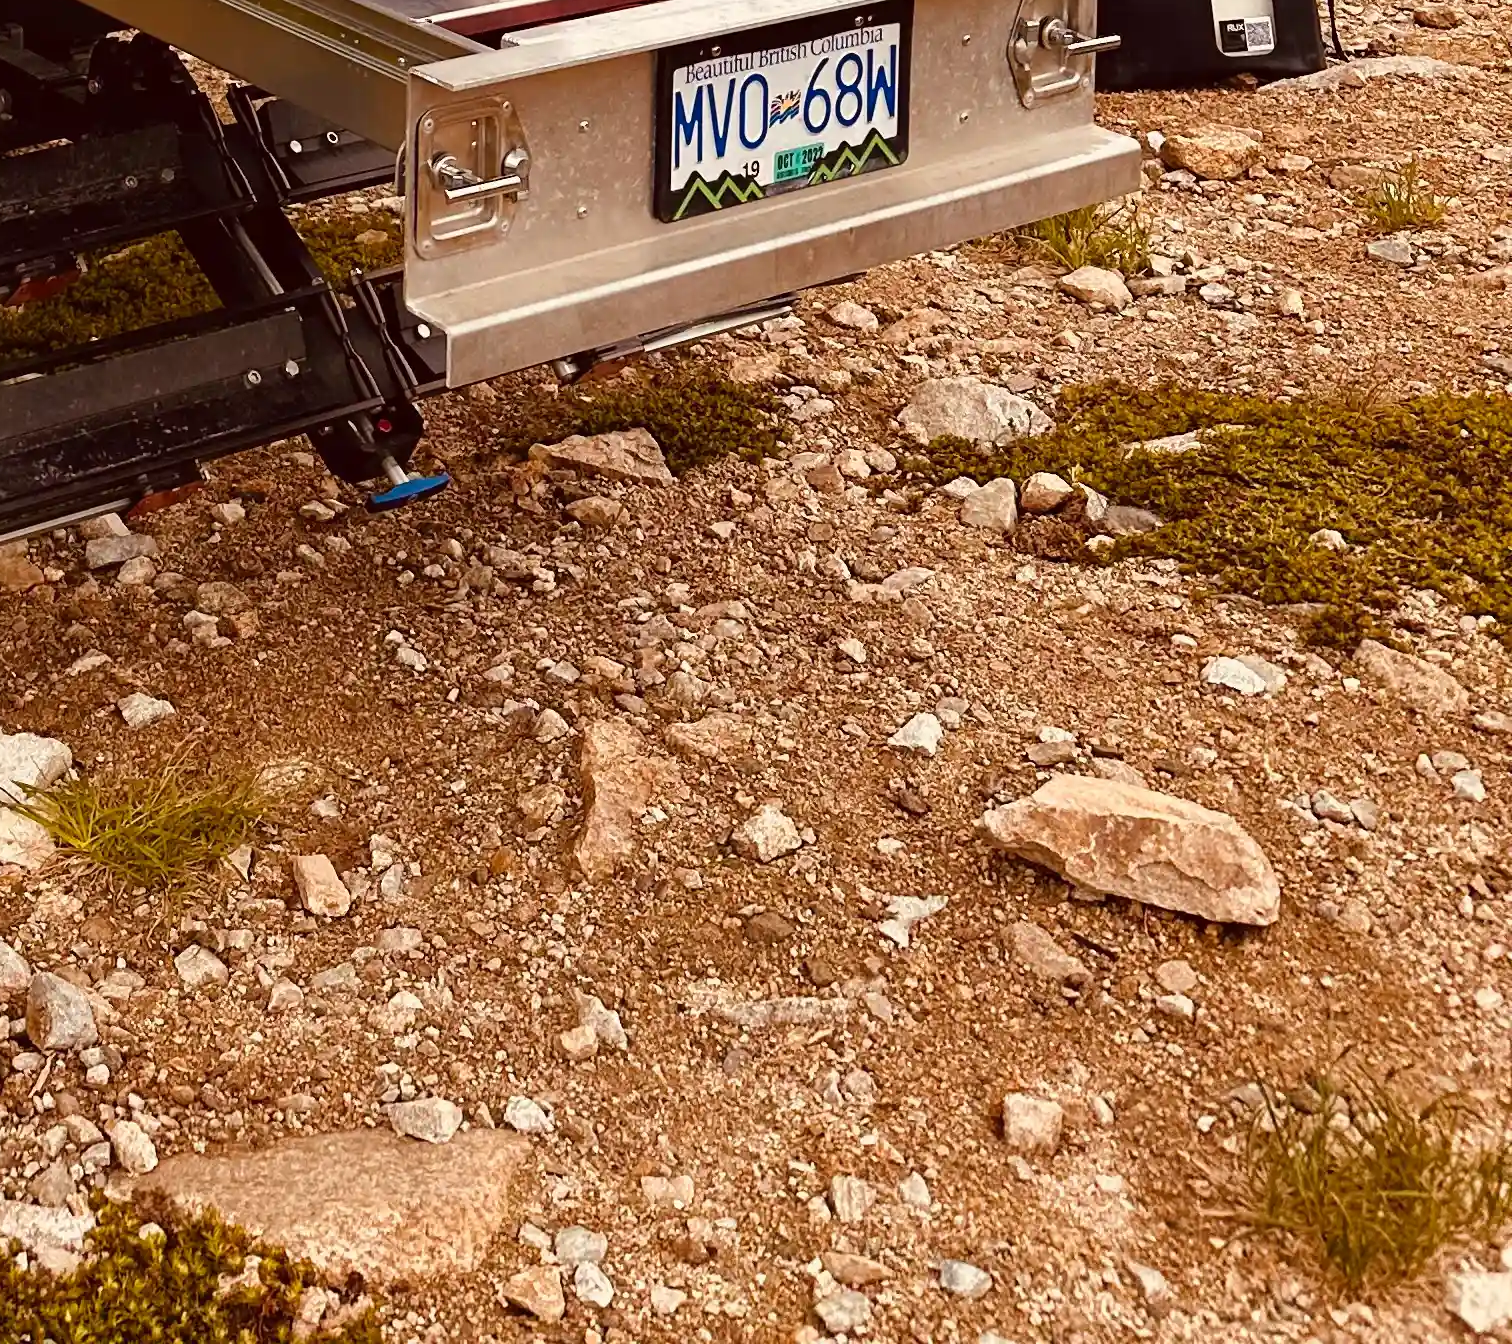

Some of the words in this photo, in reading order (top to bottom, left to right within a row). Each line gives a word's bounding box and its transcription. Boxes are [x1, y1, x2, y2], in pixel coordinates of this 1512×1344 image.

[685, 52, 754, 85] Beautiful
[758, 42, 808, 69] British
[810, 26, 884, 56] Columbia
[803, 44, 897, 134] 68W
[777, 152, 794, 170] OCT
